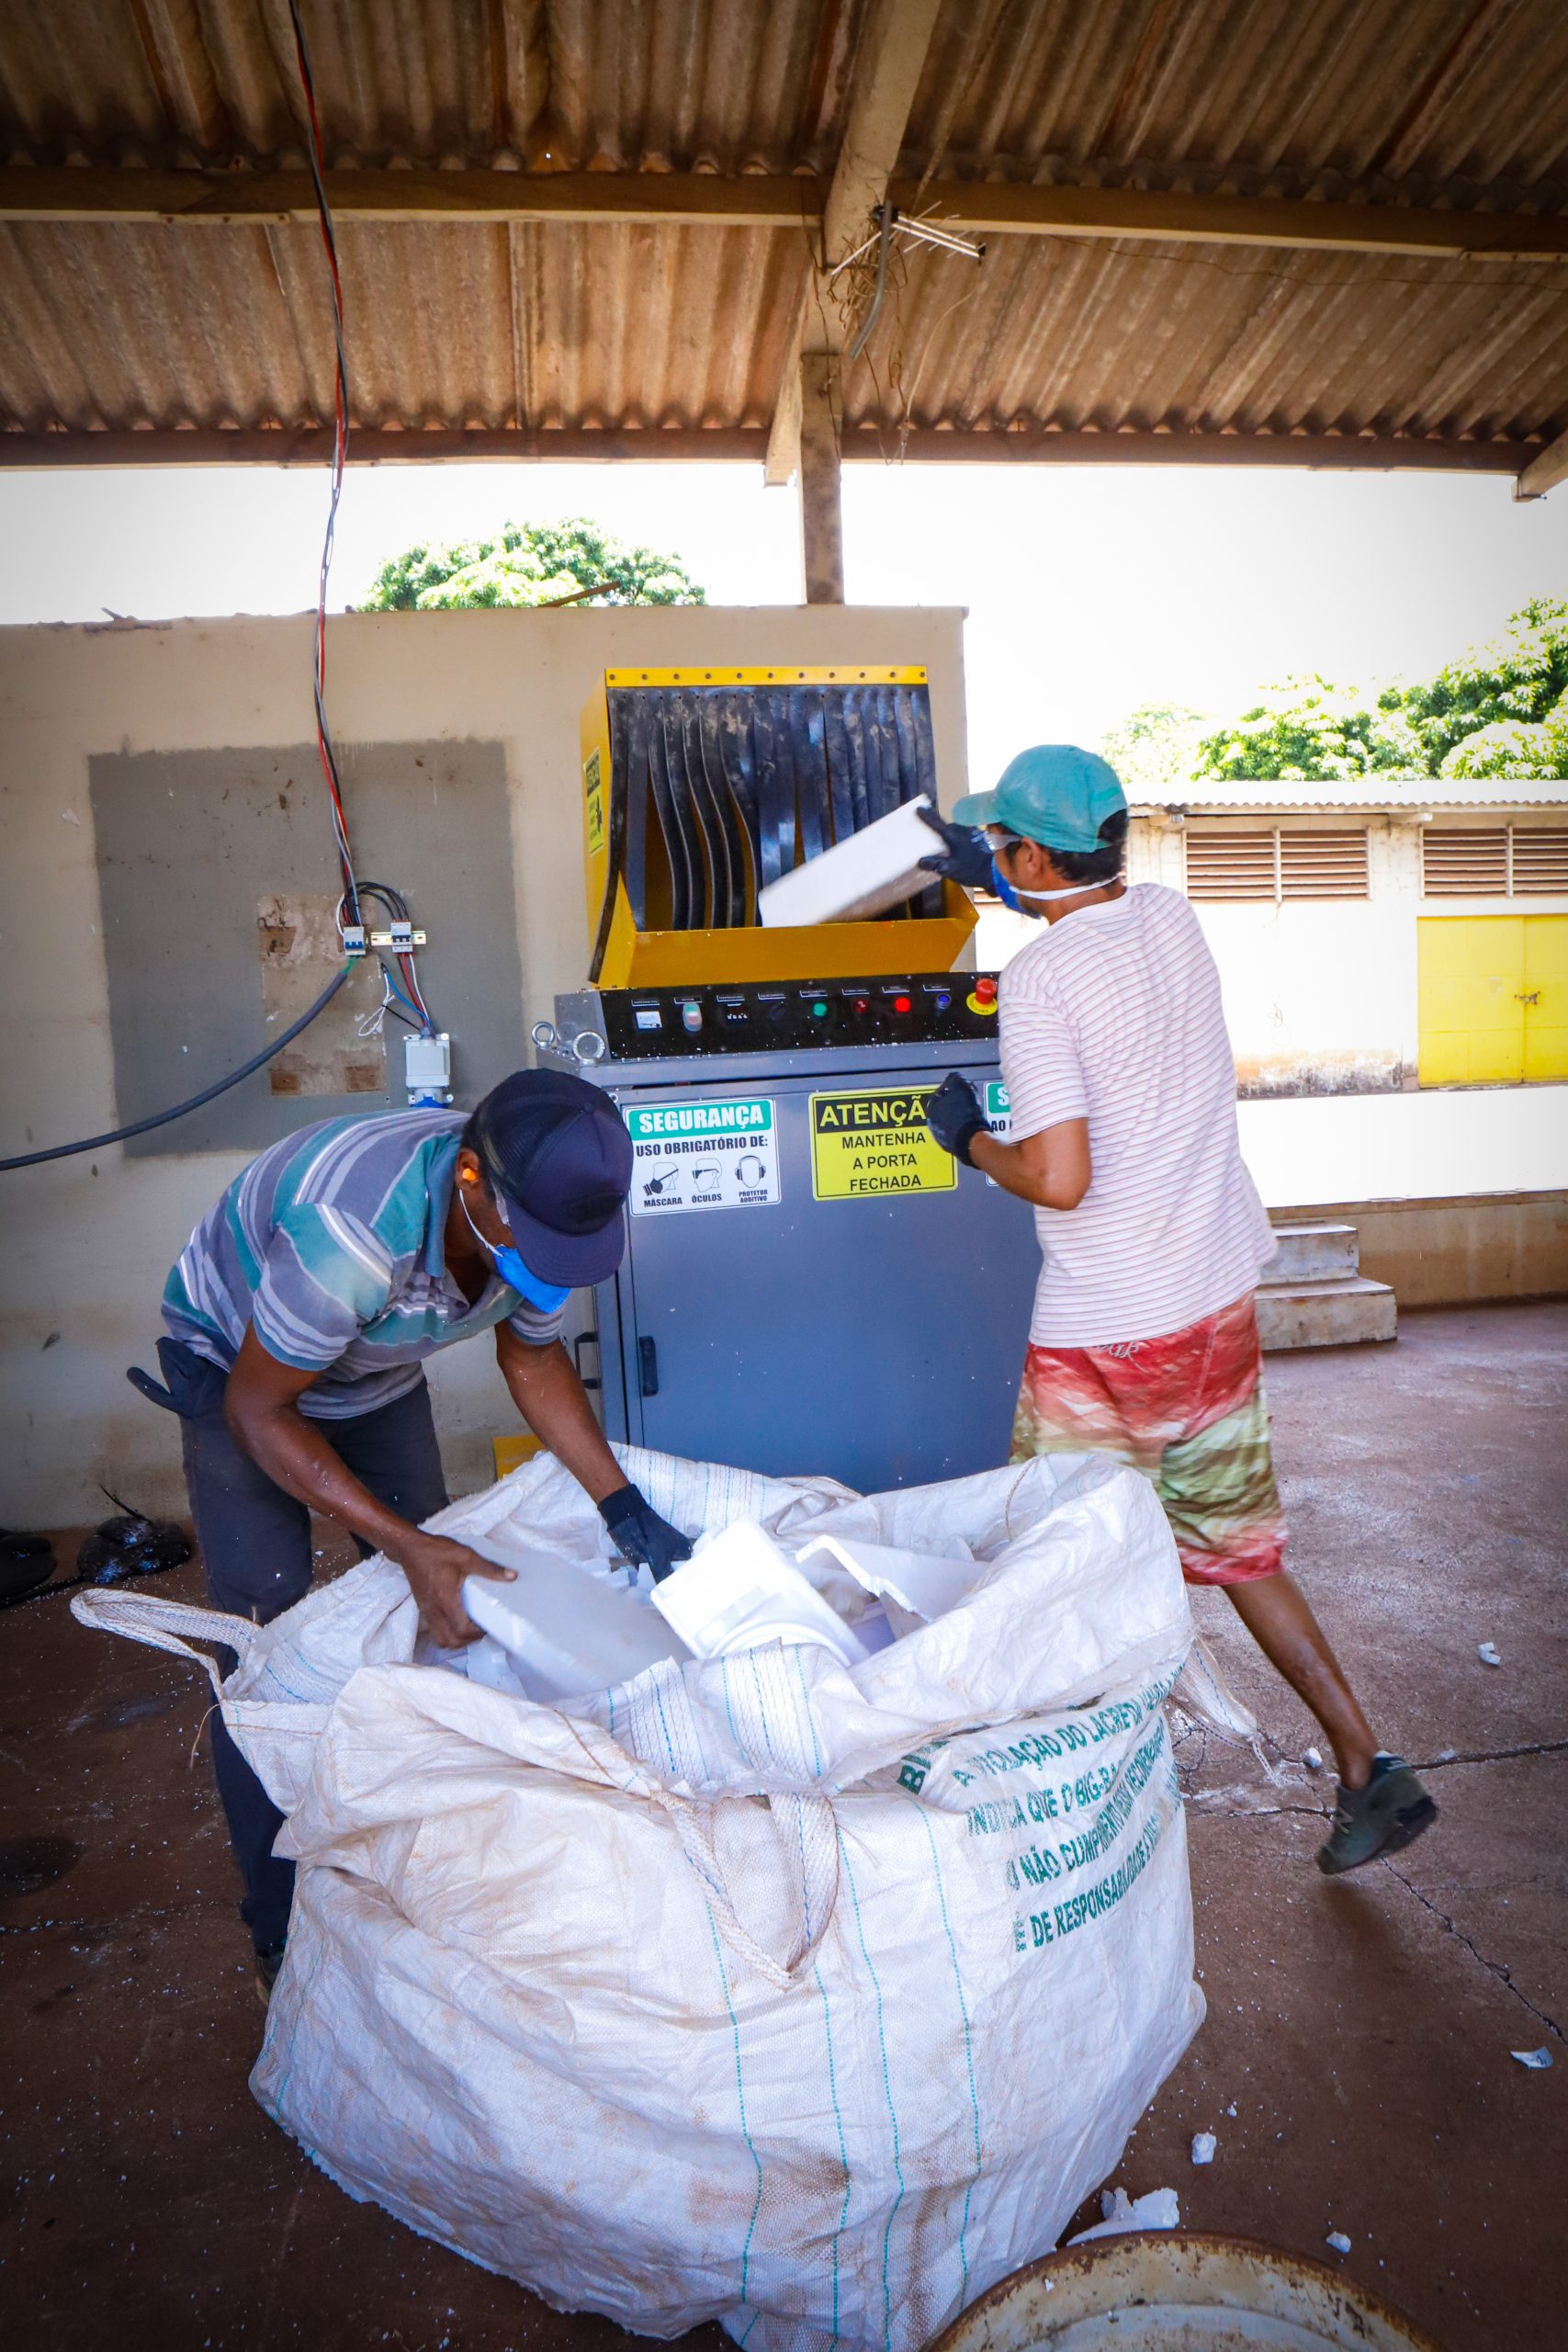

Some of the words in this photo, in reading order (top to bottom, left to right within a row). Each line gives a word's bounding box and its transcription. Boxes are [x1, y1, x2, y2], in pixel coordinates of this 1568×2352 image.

[638, 1104, 764, 1133] SEGURANÇA
[819, 1094, 927, 1127] ATENÇÃ
[636, 1144, 660, 1157] USO
[664, 1136, 747, 1155] OBRIGATÓRIO
[750, 1135, 768, 1148] DE:
[841, 1132, 926, 1149] MANTENHA
[852, 1158, 863, 1170] A
[867, 1153, 918, 1169] PORTA
[739, 1189, 768, 1197] PROTETOR
[850, 1174, 922, 1192] FECHADA
[644, 1197, 682, 1207] MÁSCARA
[692, 1193, 722, 1203] ÓCULOS
[1055, 1724, 1087, 1751] DO
[1078, 1702, 1131, 1742] LACRE
[1027, 1788, 1058, 1823] QUE
[1061, 1782, 1073, 1813] O
[1019, 1845, 1062, 1886] NÃO
[1030, 1911, 1054, 1947] DE
